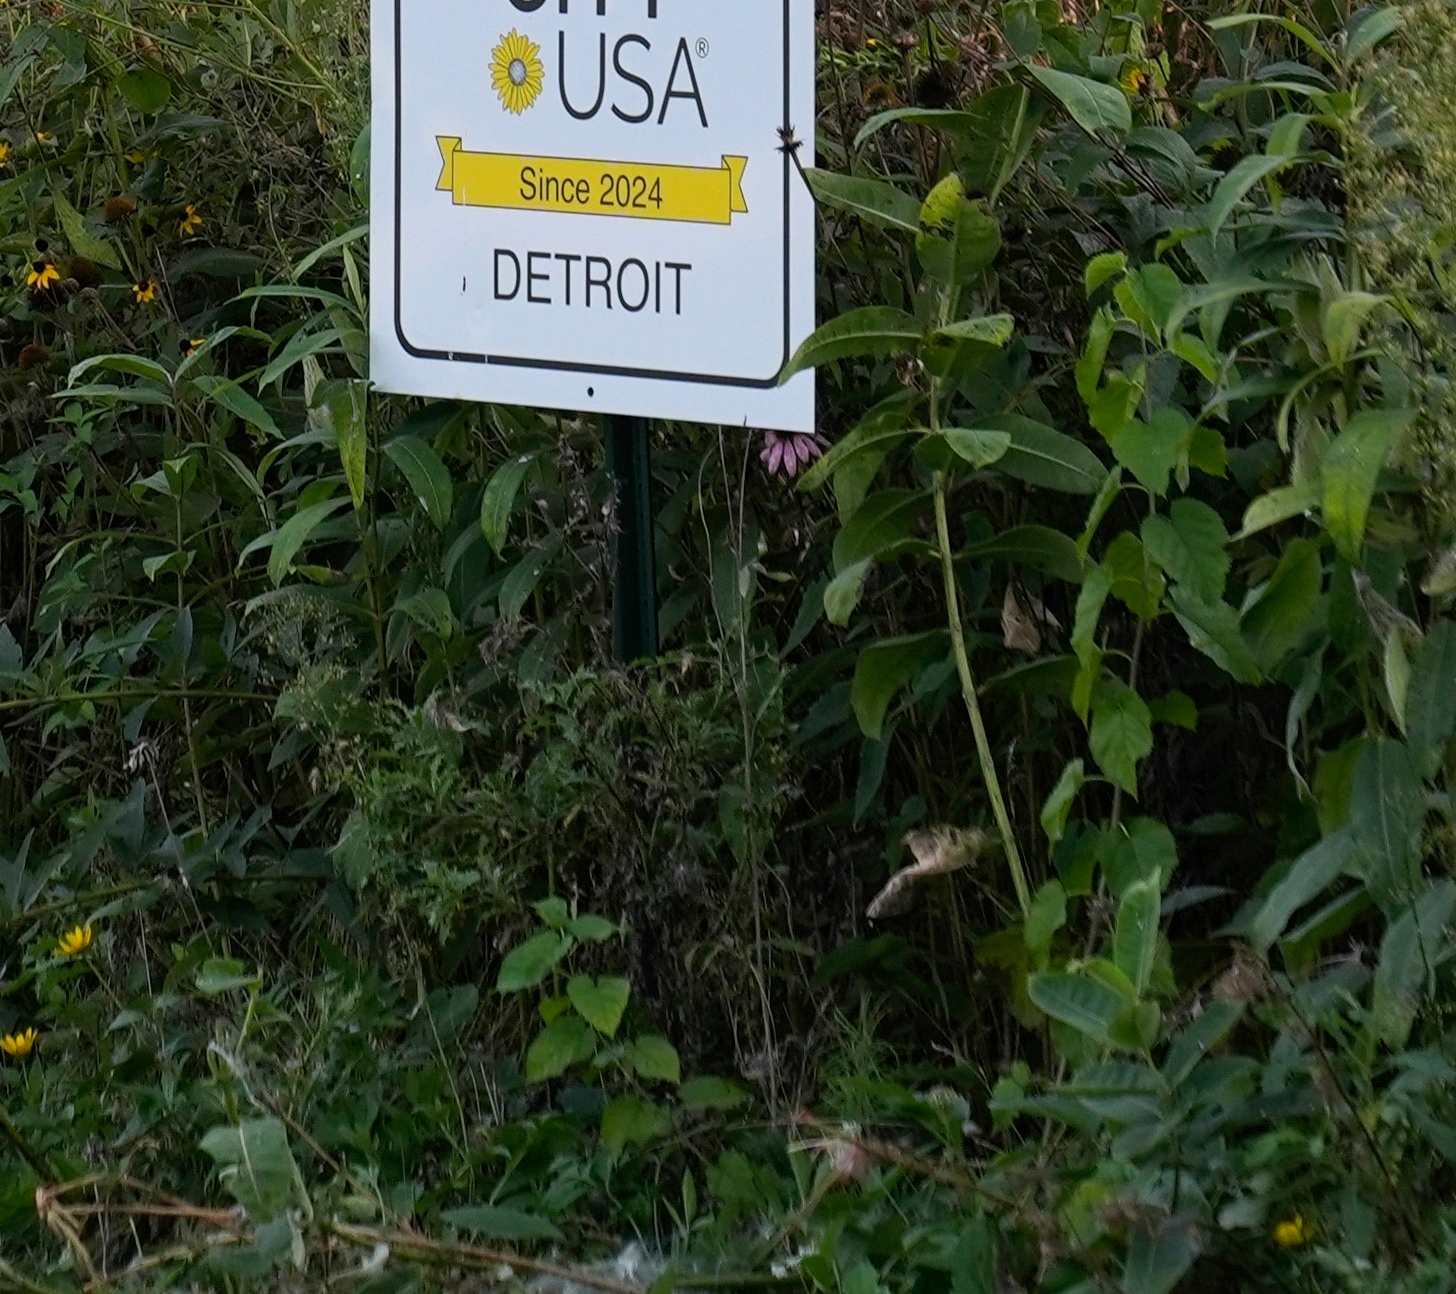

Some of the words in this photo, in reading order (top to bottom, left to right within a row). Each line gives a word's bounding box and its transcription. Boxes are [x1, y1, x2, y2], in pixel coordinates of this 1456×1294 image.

[519, 166, 590, 205] Since
[599, 173, 664, 210] 2024
[493, 248, 692, 315] DETROIT
